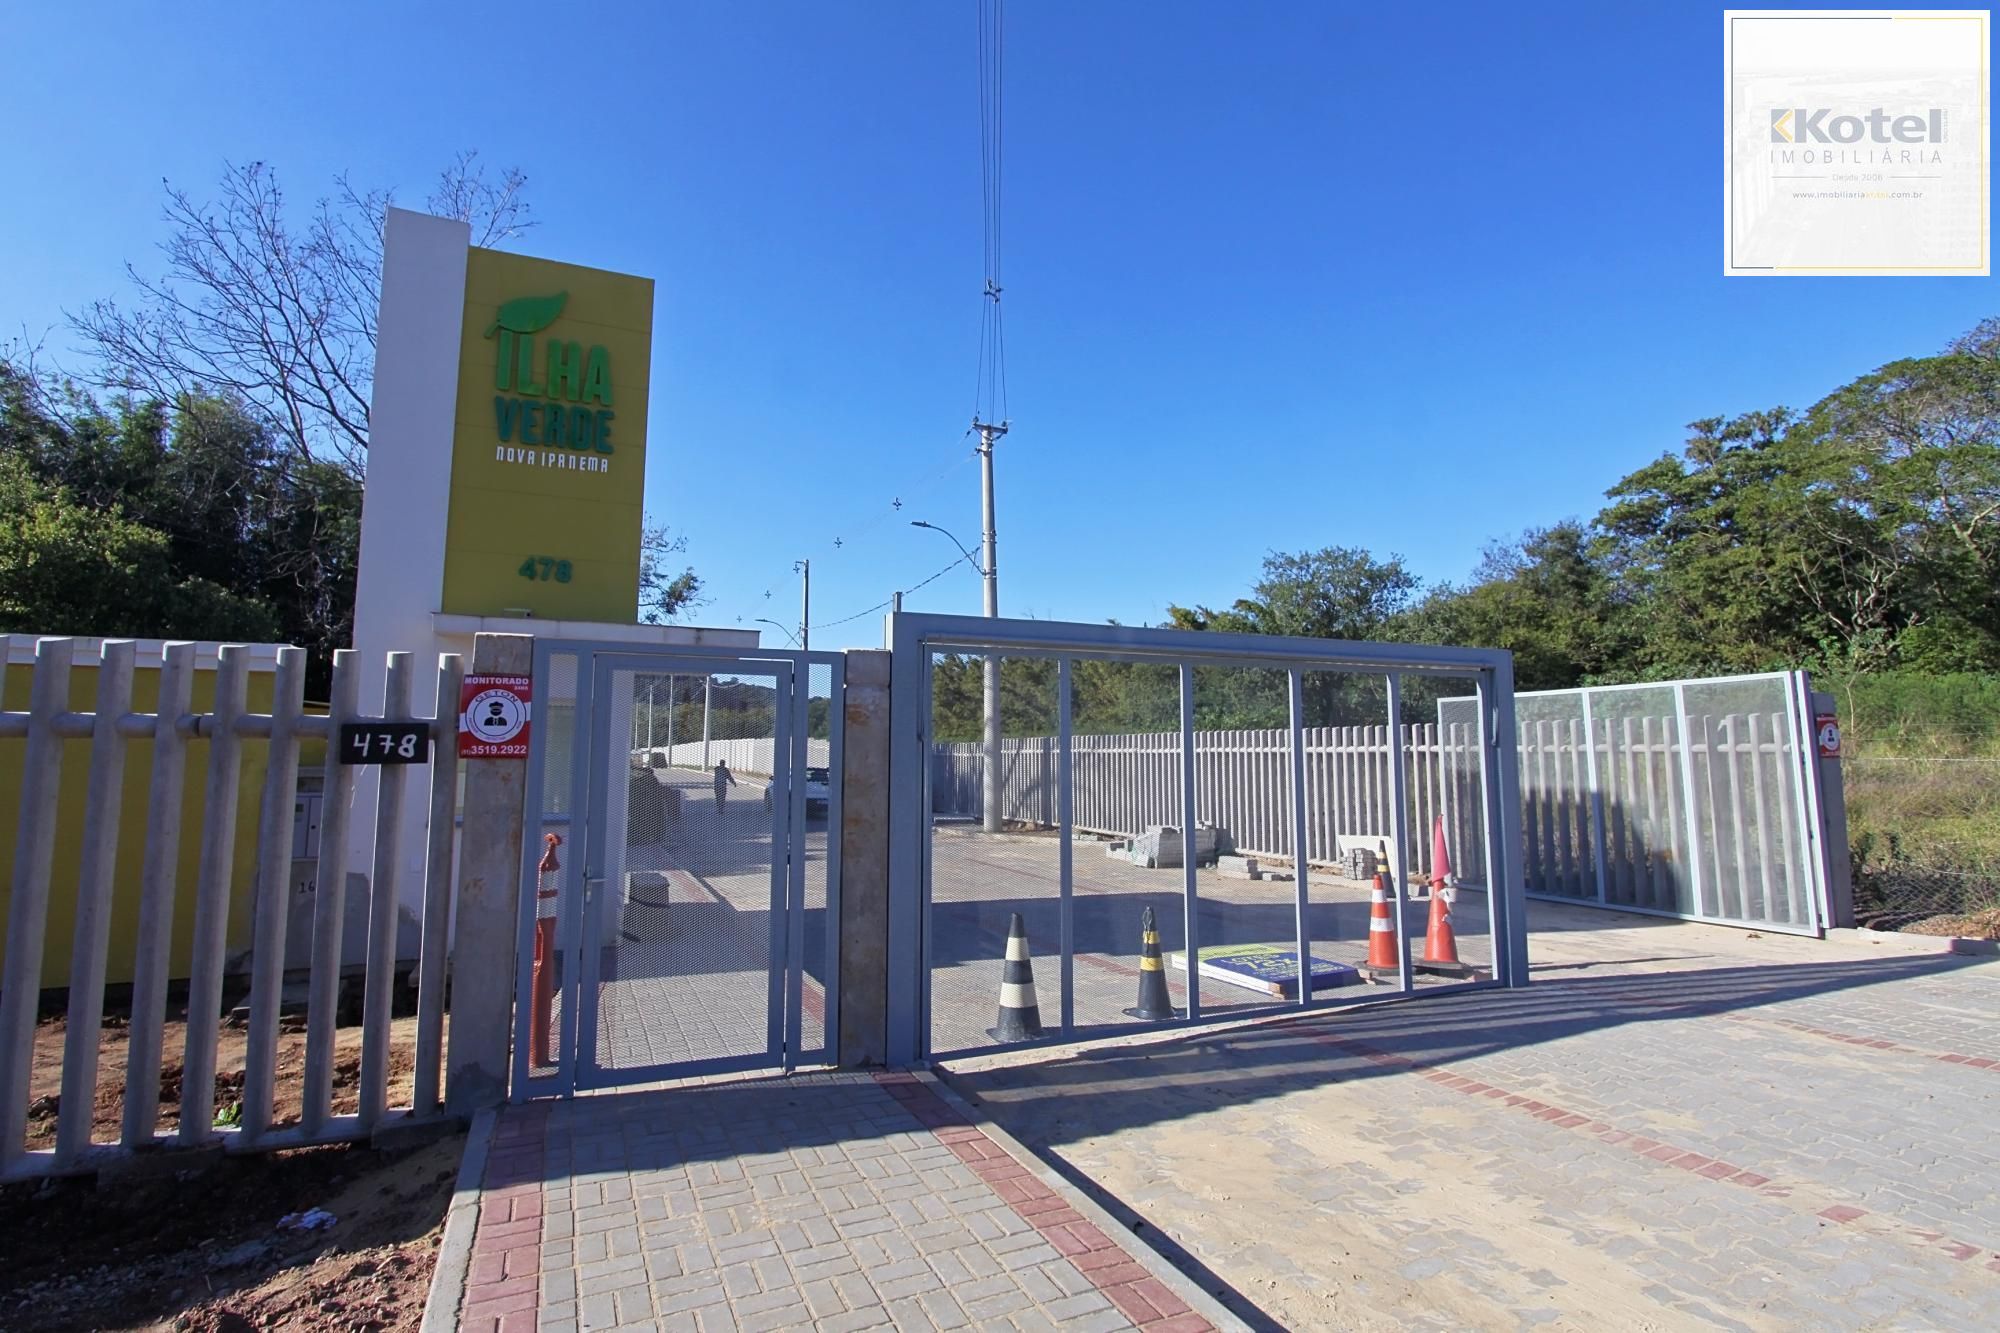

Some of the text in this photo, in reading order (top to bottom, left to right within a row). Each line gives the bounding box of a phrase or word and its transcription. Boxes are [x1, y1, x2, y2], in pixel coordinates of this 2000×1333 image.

[495, 331, 614, 407] ILHA
[493, 395, 616, 455] VERDE
[496, 445, 609, 473] NOVA IPANEMA
[517, 556, 573, 584] 478
[463, 676, 530, 685] MONITORADO
[353, 732, 418, 759] 478
